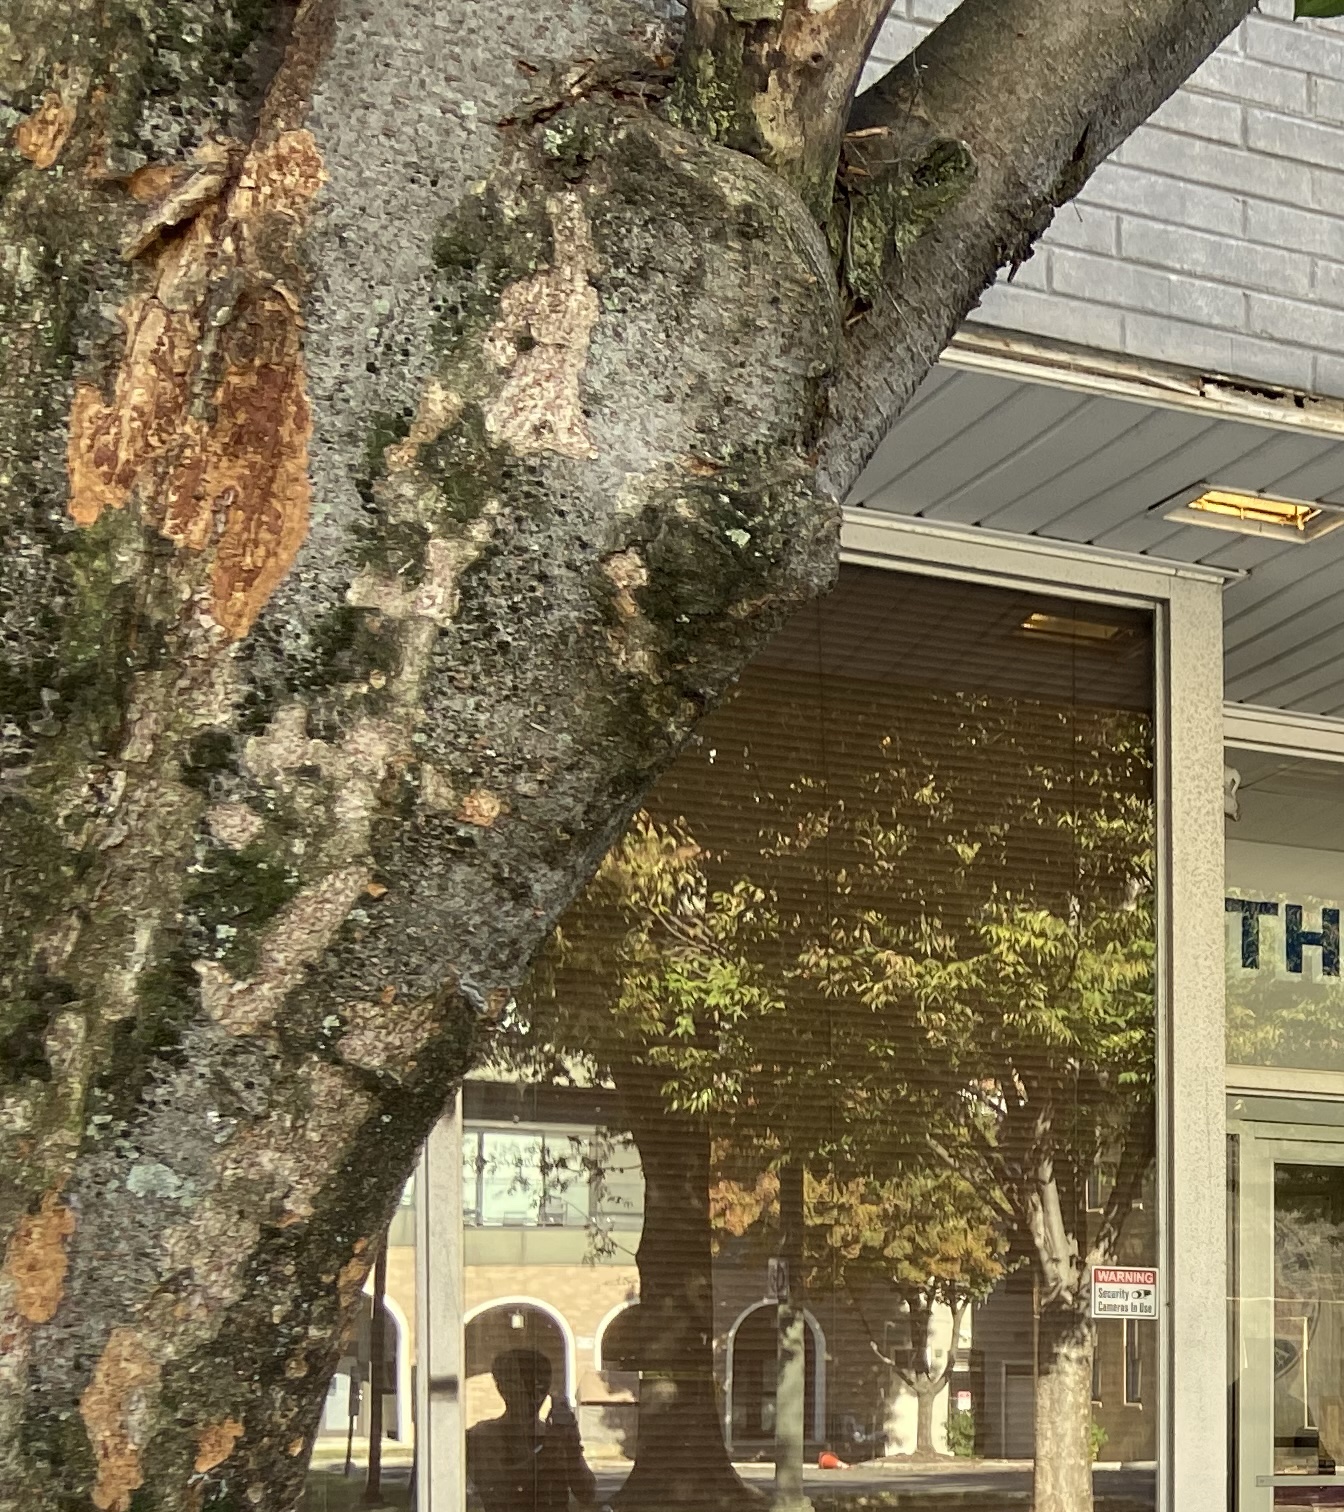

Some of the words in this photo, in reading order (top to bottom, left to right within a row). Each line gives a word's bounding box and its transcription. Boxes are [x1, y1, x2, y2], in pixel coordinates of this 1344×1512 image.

[1098, 1270, 1153, 1283] WARNING
[1098, 1288, 1129, 1301] Security
[1098, 1301, 1128, 1312] Cameras
[1139, 1302, 1152, 1313] Use
